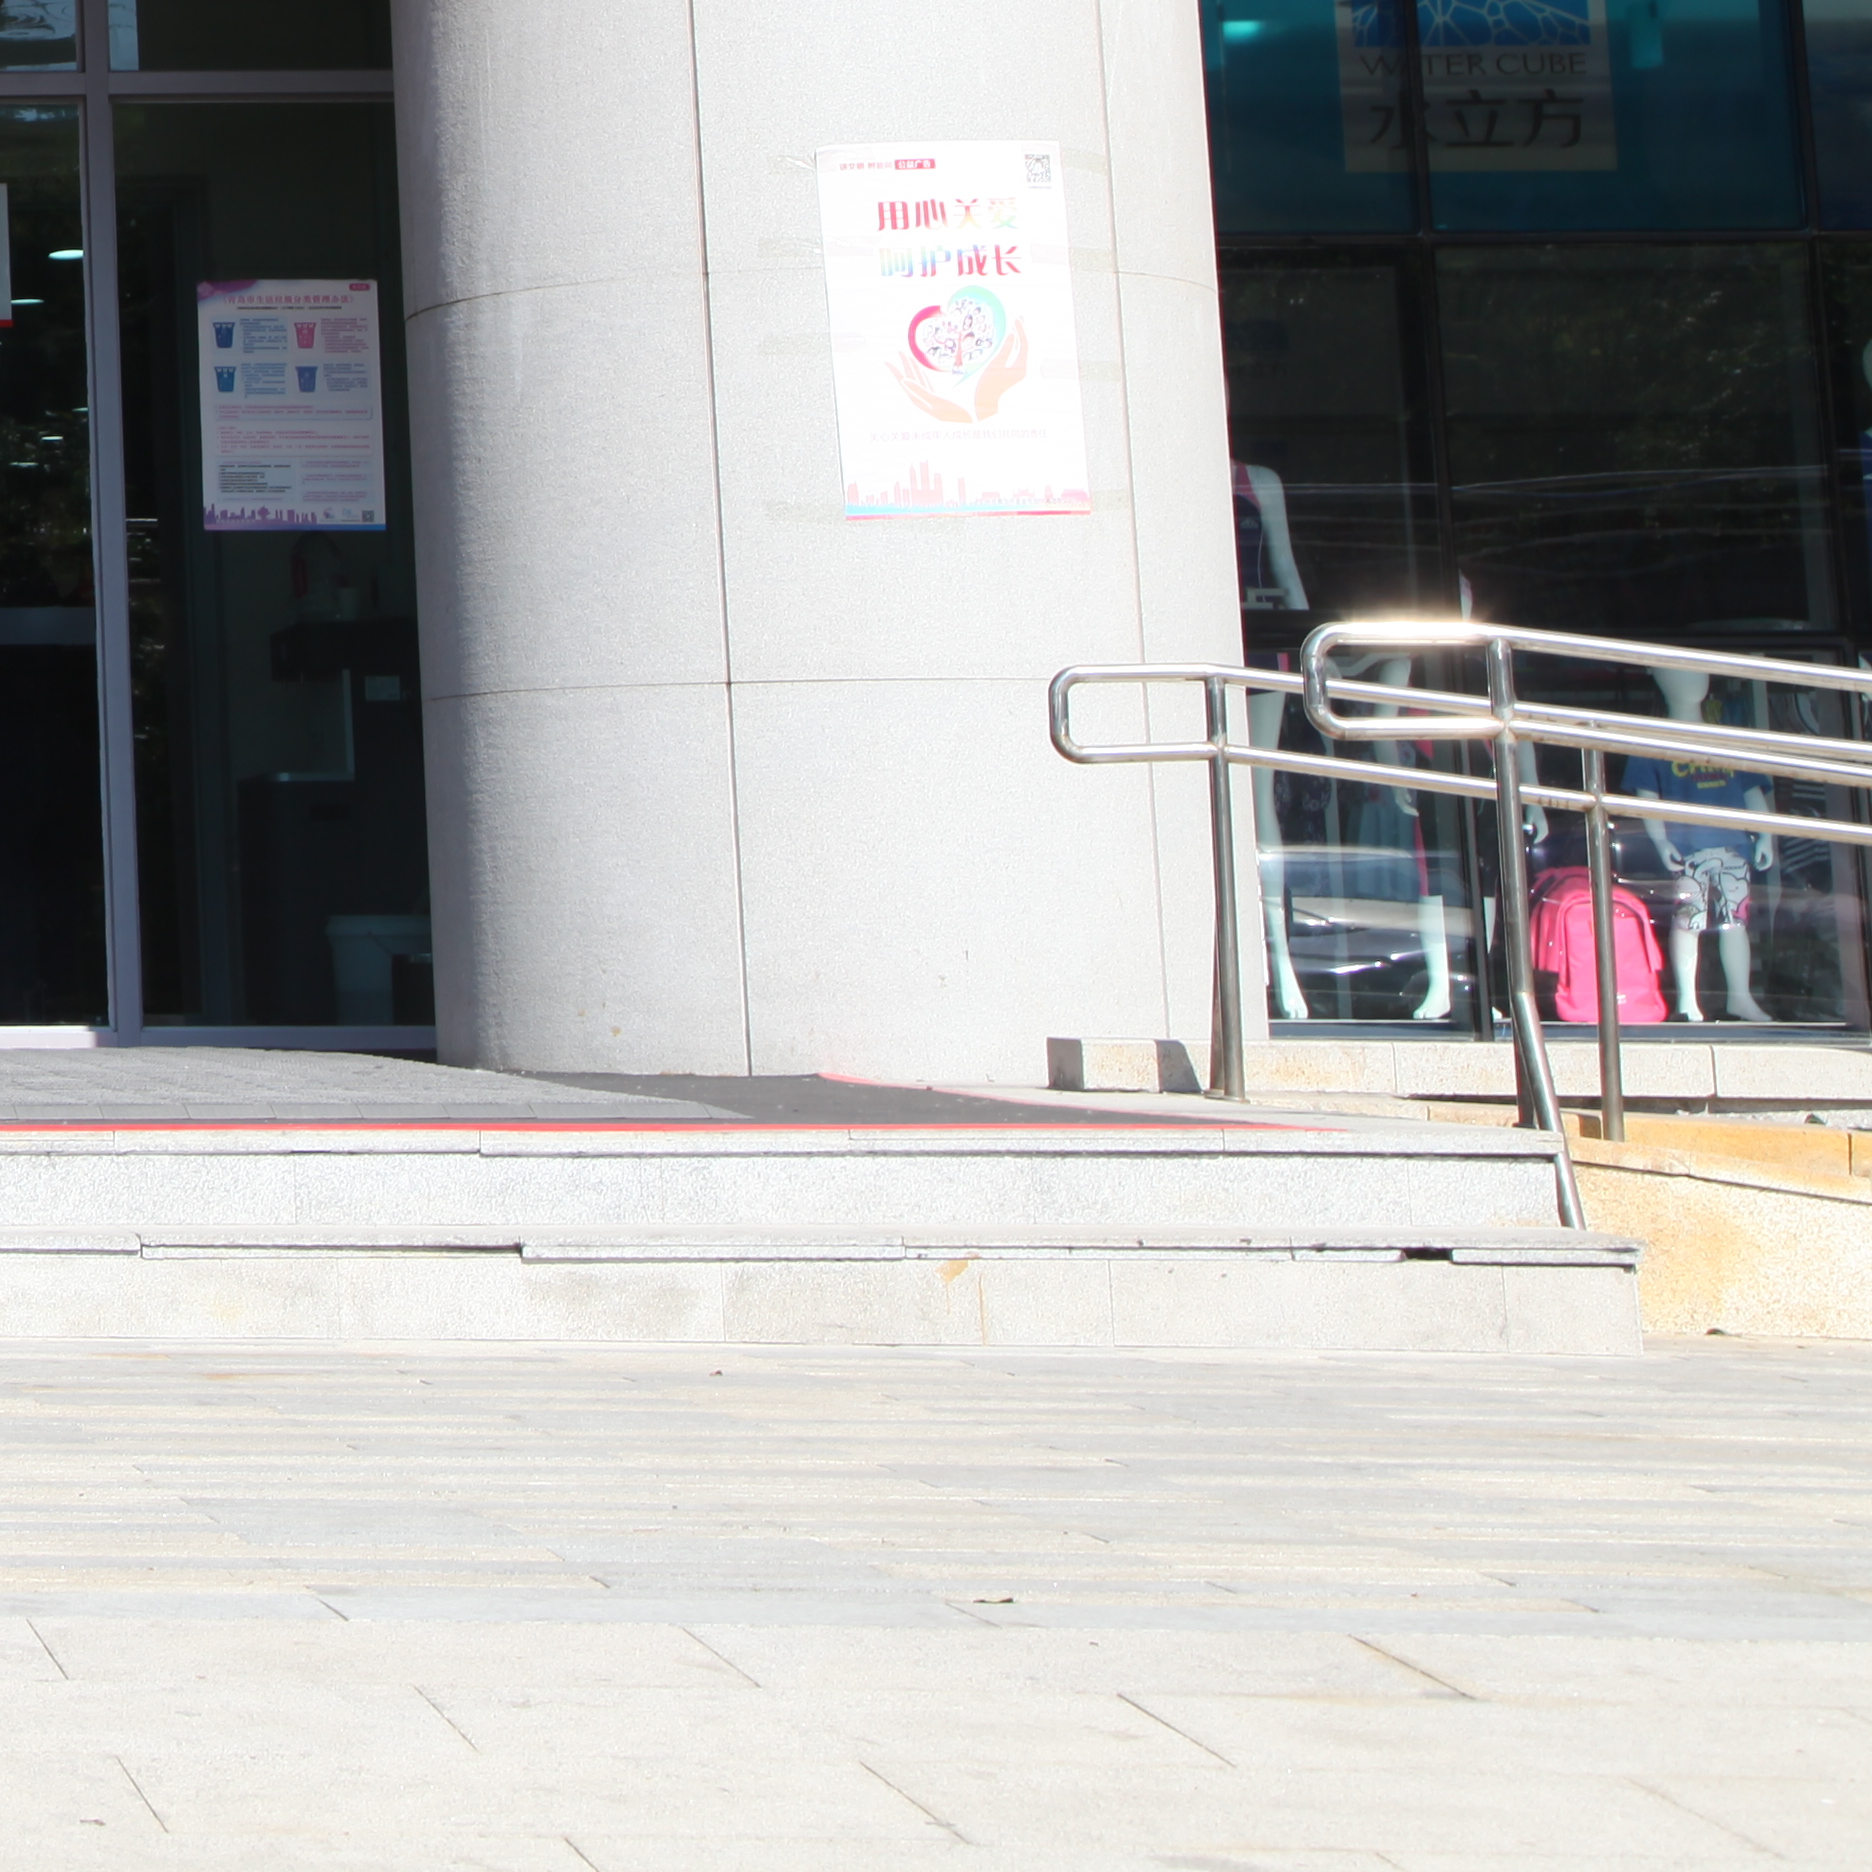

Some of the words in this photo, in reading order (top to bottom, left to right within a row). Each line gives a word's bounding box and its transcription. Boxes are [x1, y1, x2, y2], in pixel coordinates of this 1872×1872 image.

[1360, 53, 1486, 76] WTER
[1496, 52, 1588, 75] CUBE
[877, 197, 1020, 232] 用心关爱
[878, 244, 1023, 278] 呵护成长
